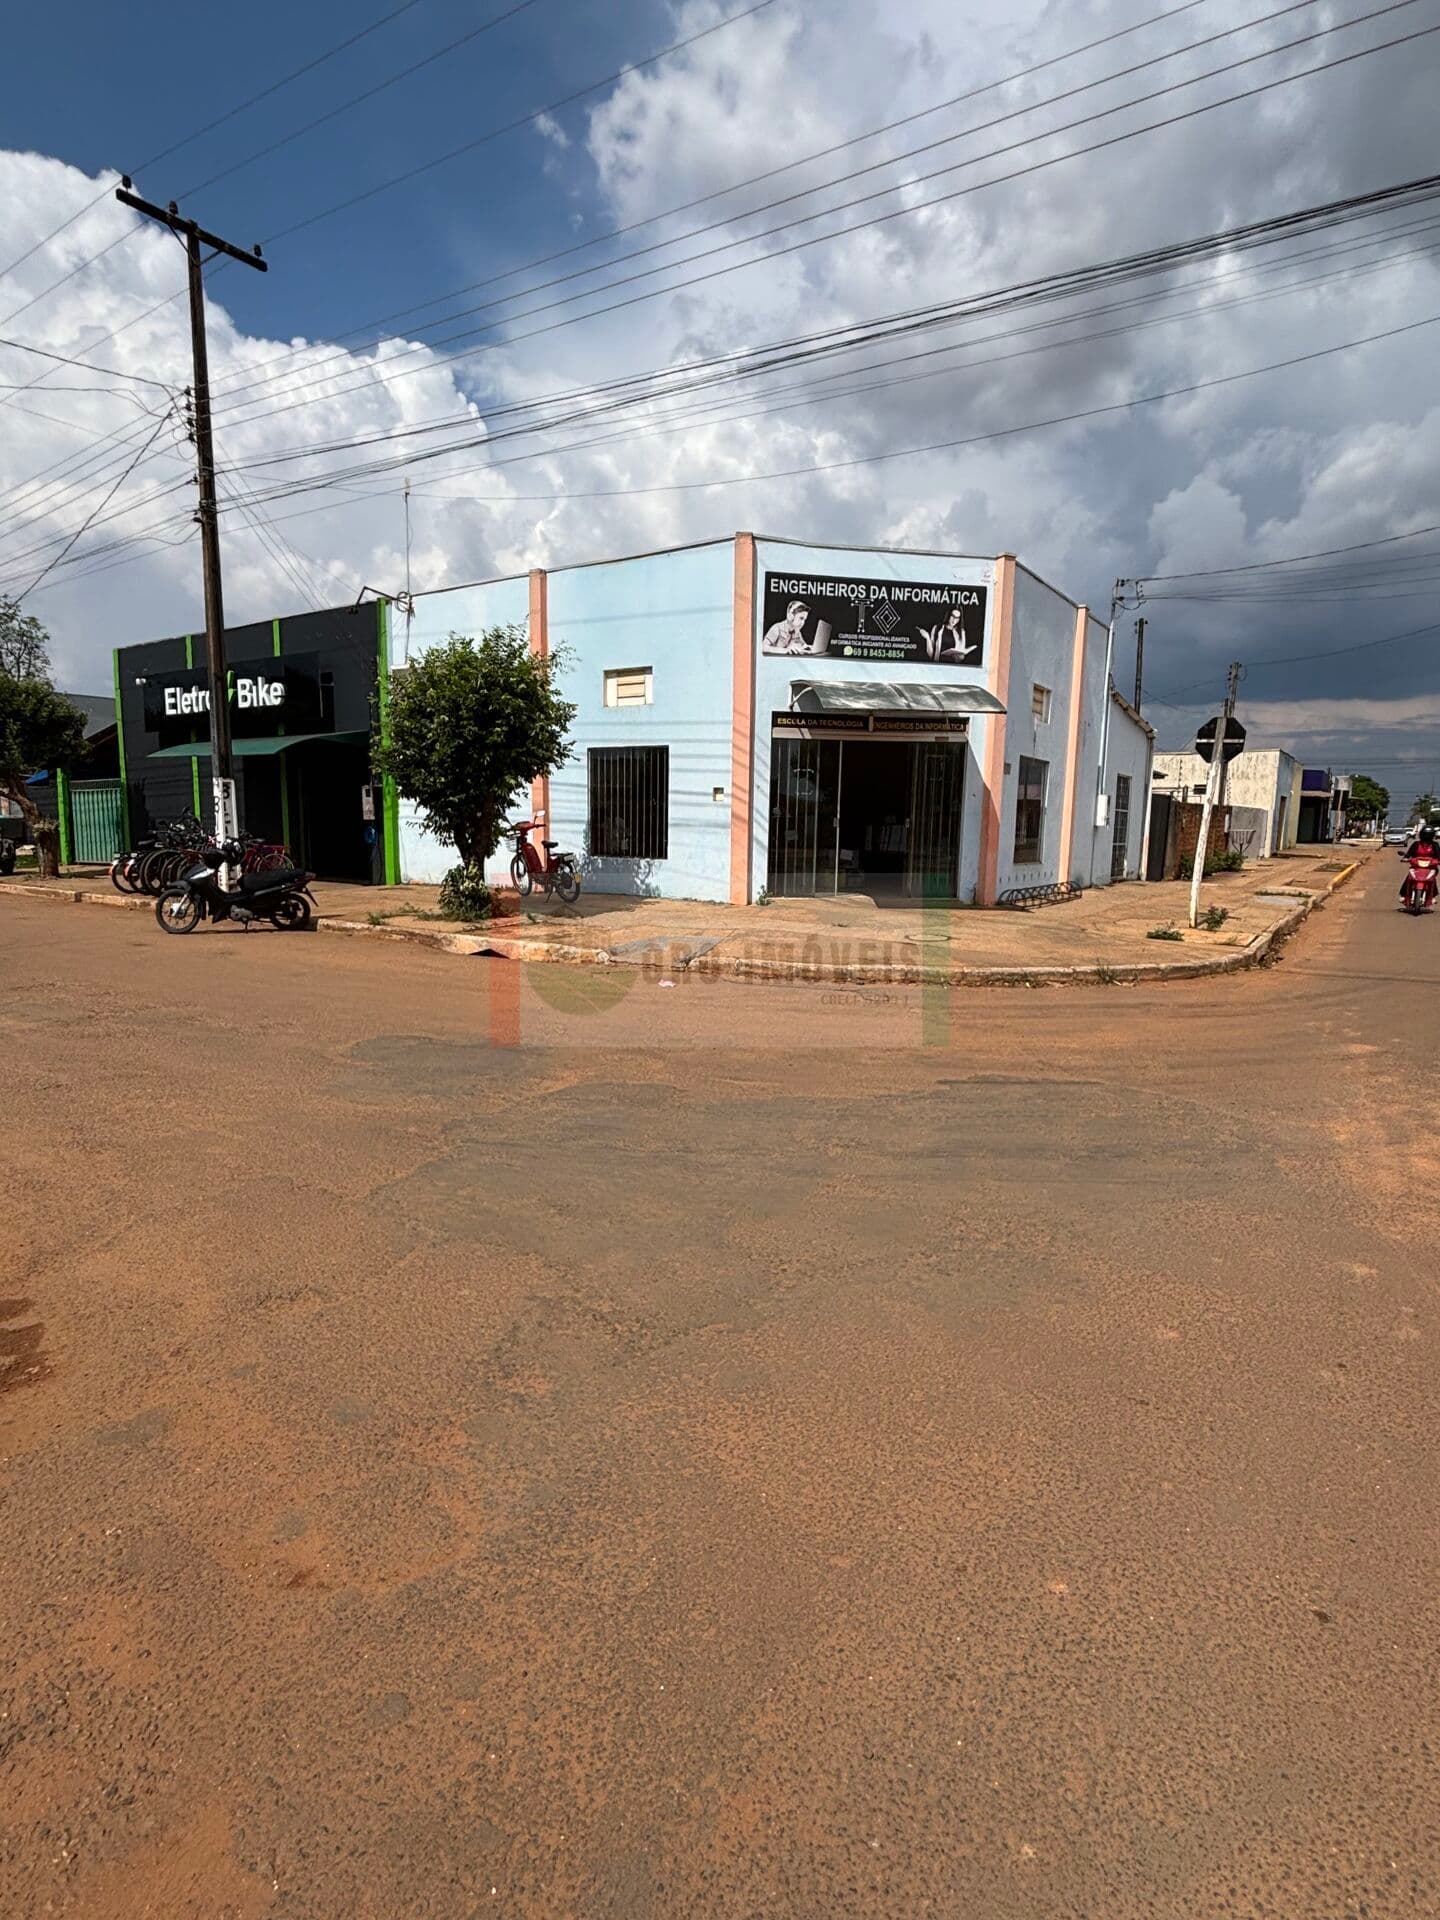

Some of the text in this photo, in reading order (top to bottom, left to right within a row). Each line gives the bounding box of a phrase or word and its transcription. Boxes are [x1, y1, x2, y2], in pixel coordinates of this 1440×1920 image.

[770, 578, 980, 605] ENGENHEIROS DA INFORMÁTICA
[236, 676, 285, 709] Bike
